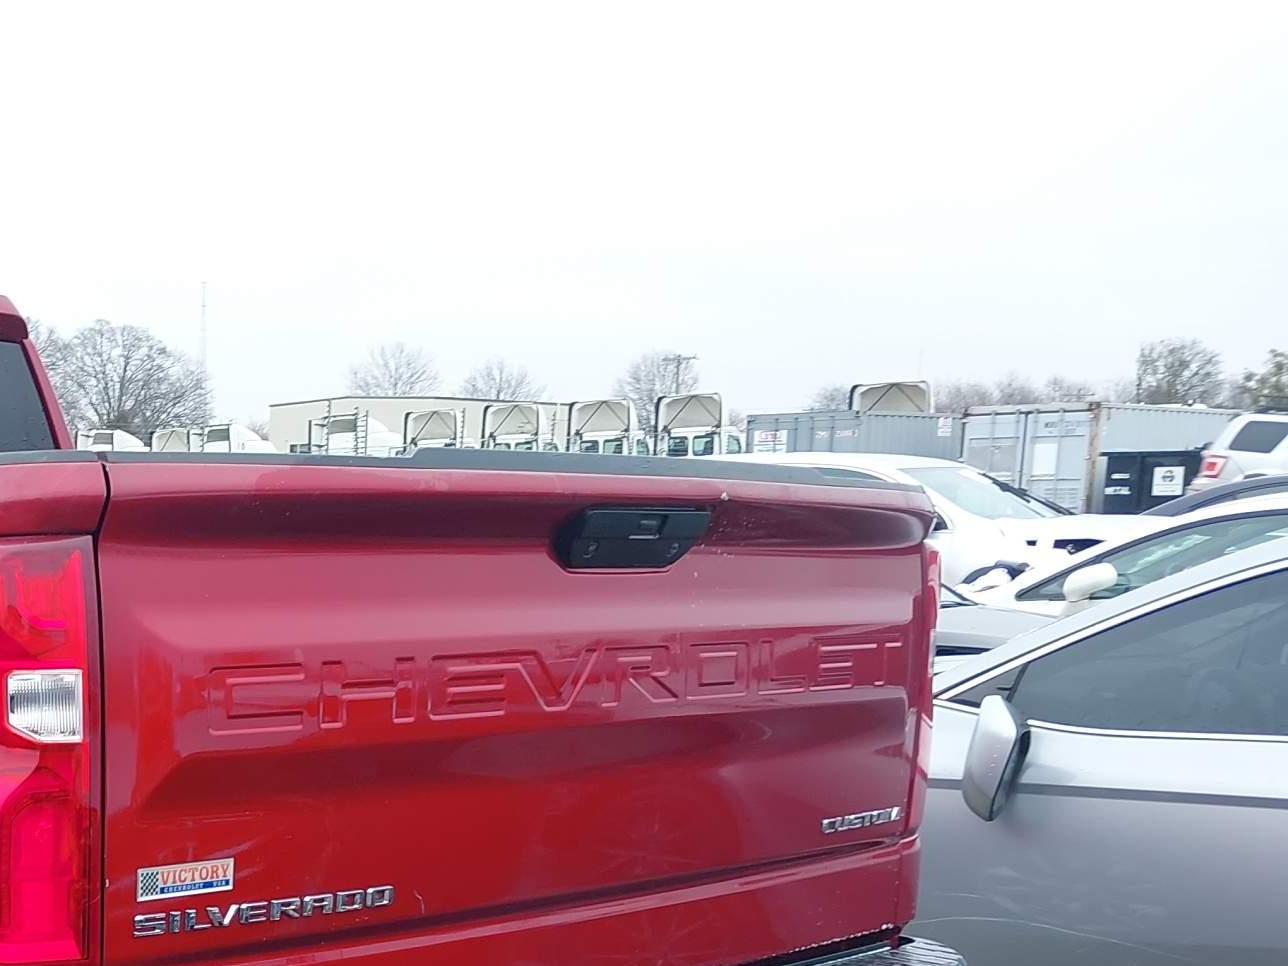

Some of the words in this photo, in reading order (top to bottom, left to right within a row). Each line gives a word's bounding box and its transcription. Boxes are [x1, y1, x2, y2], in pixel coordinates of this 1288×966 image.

[208, 633, 905, 736] CHEVROLET
[161, 863, 229, 885] VICTORY
[133, 885, 395, 938] SILVERADO
